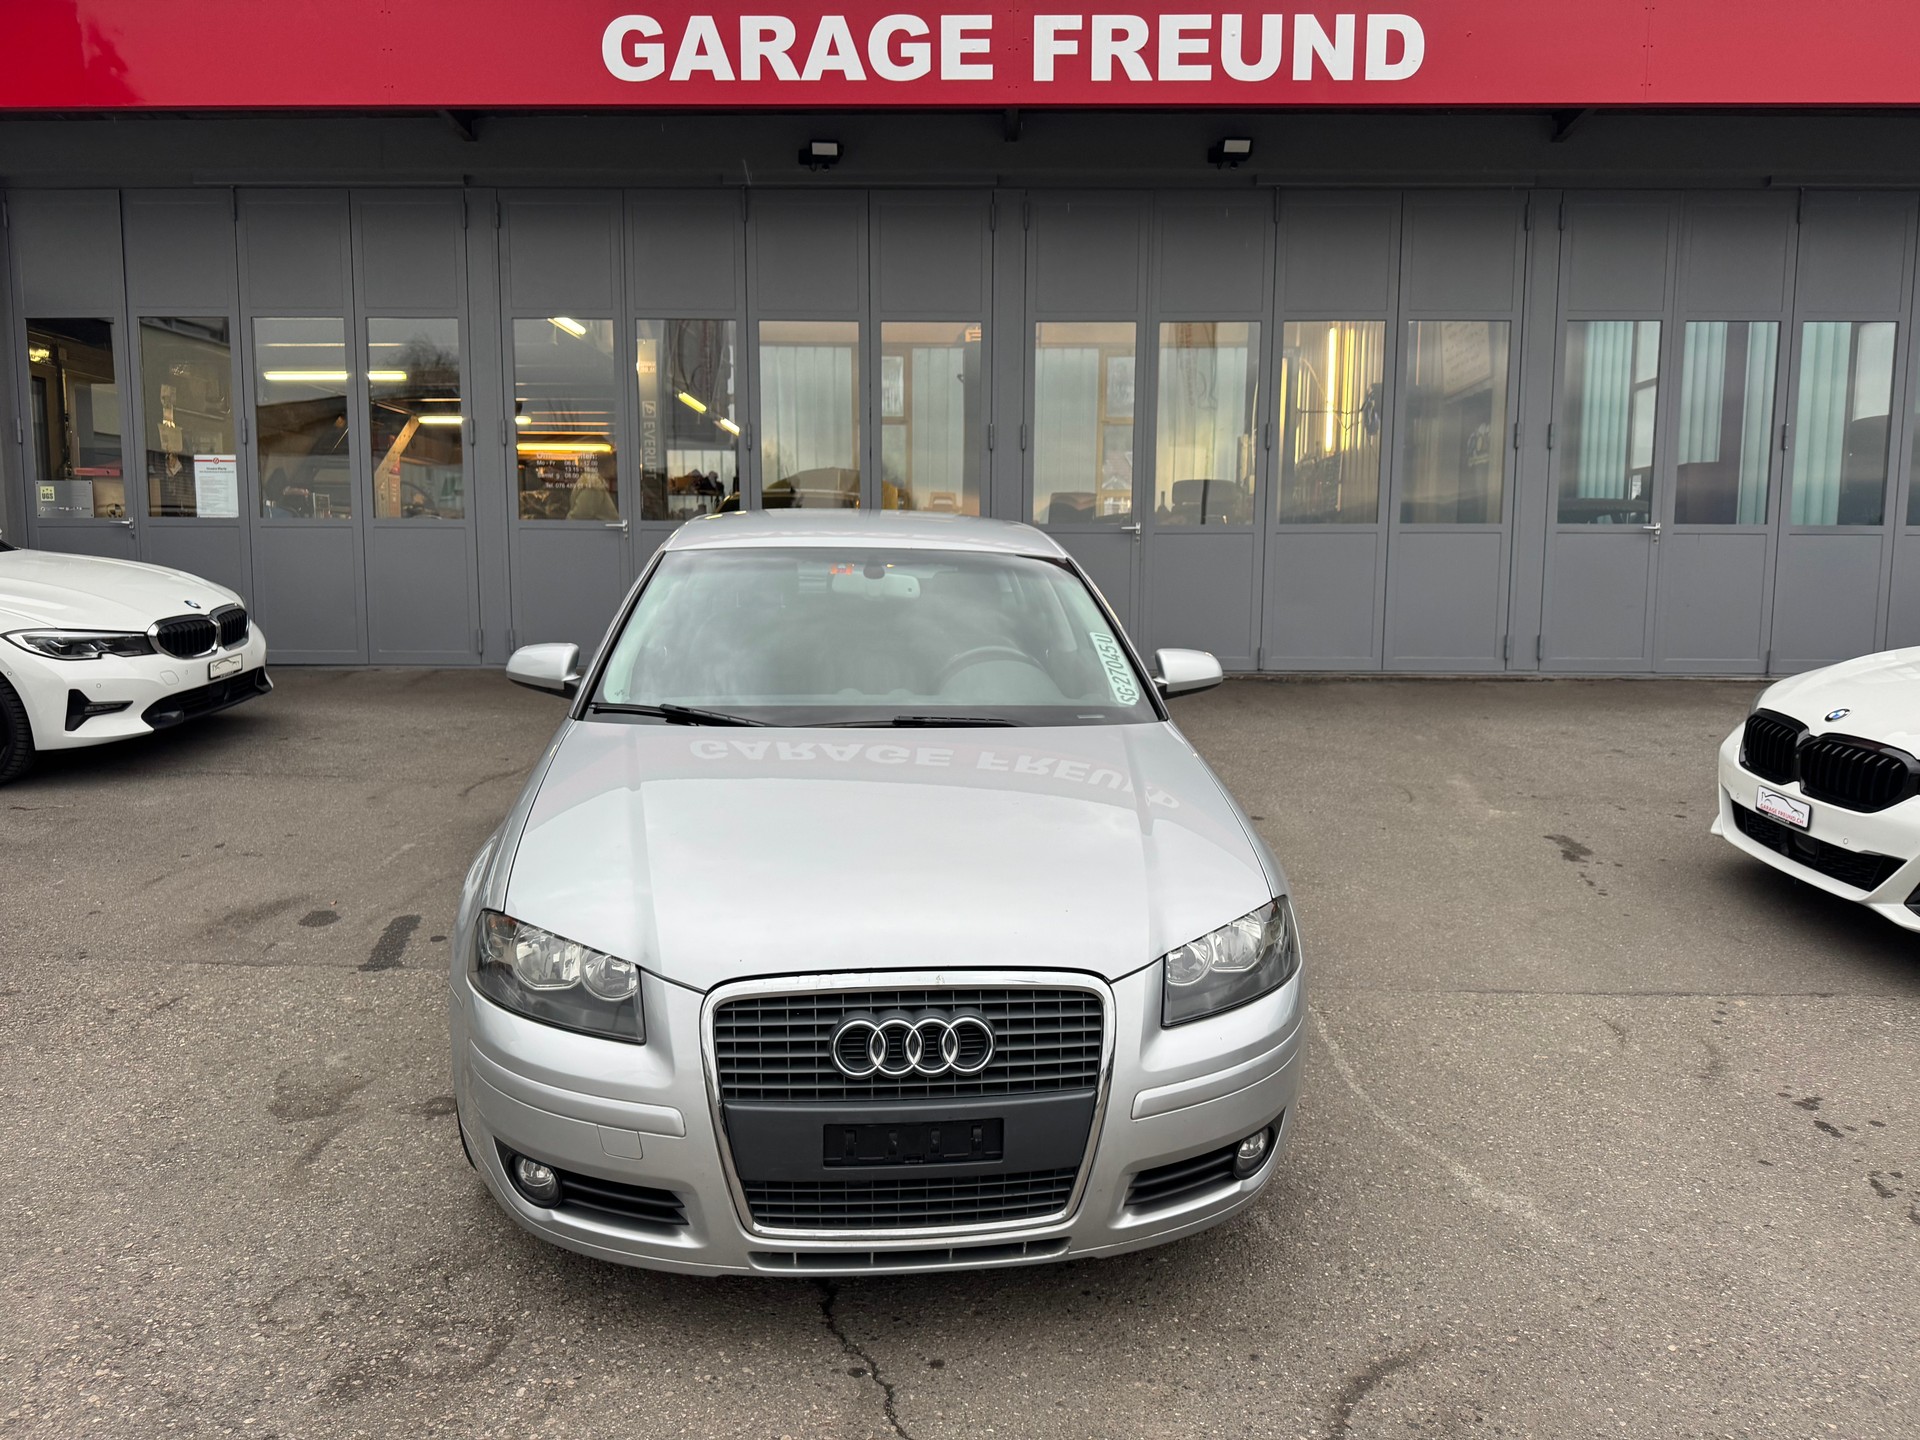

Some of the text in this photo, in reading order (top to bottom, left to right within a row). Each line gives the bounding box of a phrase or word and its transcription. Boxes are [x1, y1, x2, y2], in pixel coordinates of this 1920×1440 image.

[601, 13, 1426, 83] GARAGE FREUND
[643, 421, 656, 479] EVERLIFT
[41, 492, 54, 500] UGS
[1760, 803, 1777, 814] GARAGE
